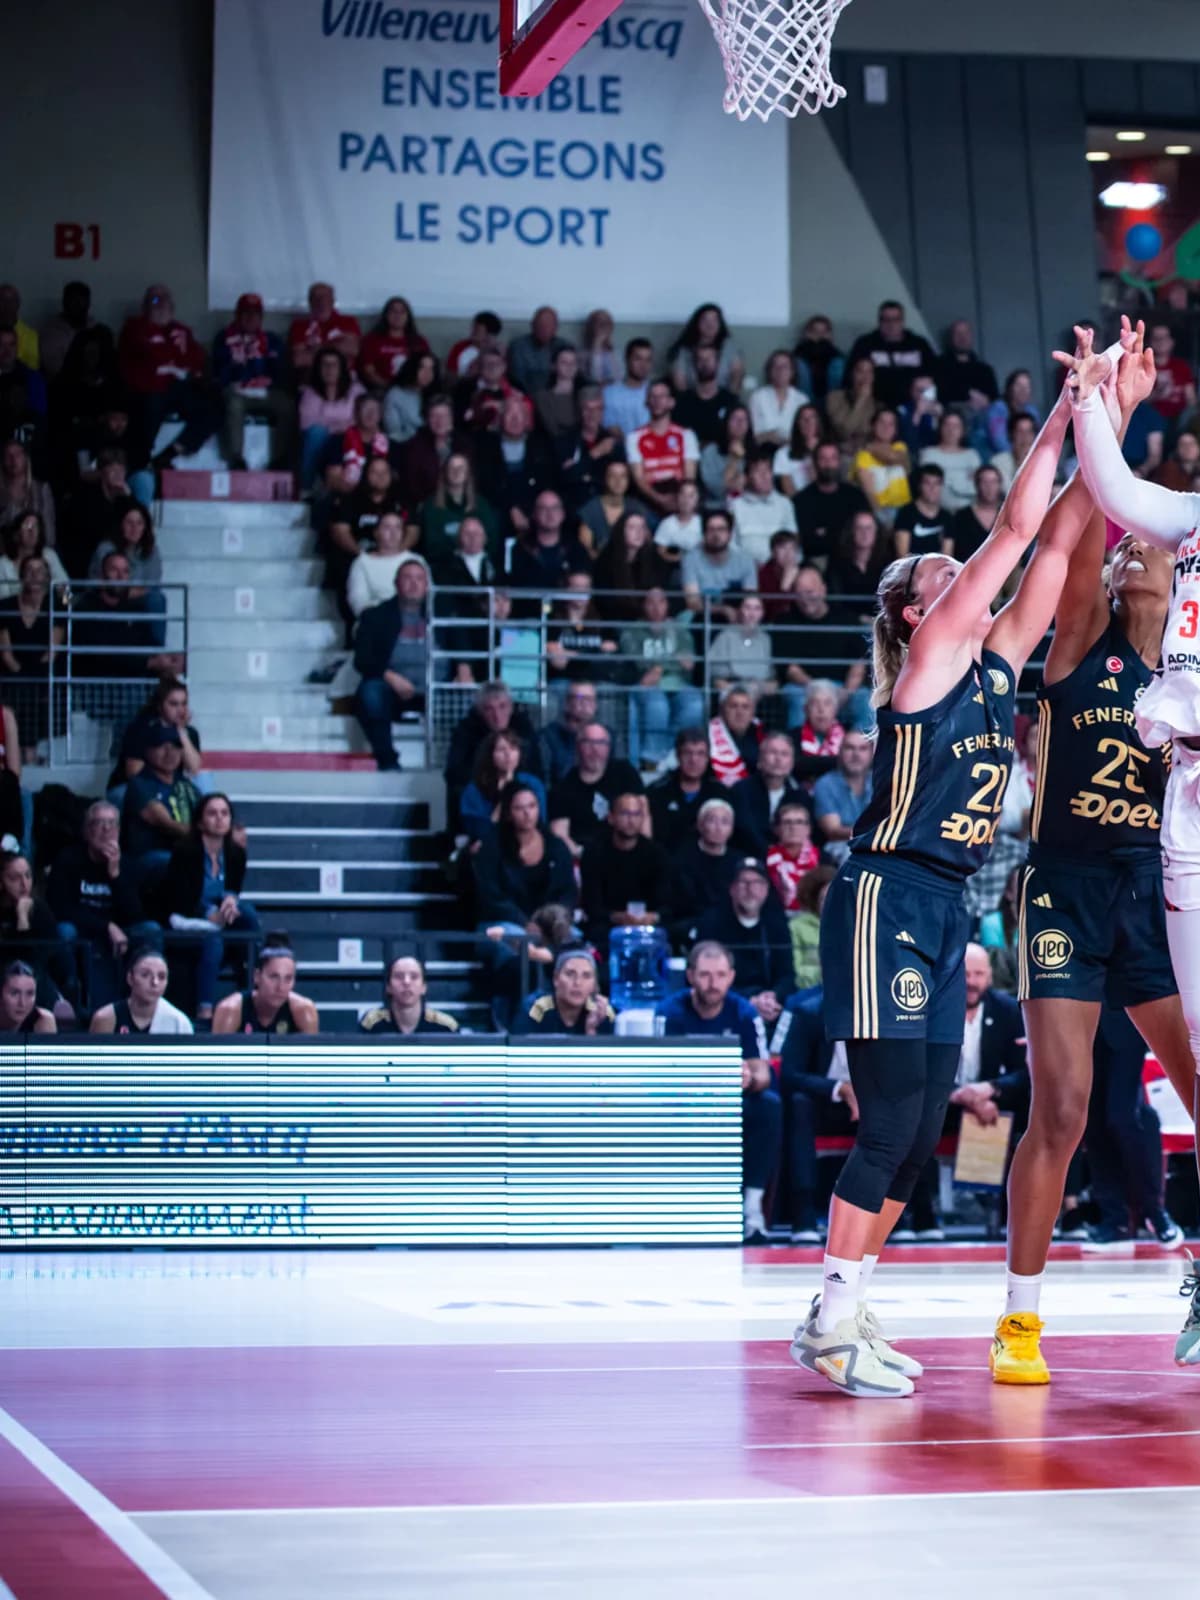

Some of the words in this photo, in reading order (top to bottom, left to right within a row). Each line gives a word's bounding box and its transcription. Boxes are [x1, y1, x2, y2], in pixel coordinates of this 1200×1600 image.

[320, 0, 499, 44] Villeneuv
[338, 131, 666, 182] PARTAGEONS
[54, 223, 100, 260] B1
[395, 202, 440, 241] LE
[457, 204, 610, 247] SPORT
[1072, 706, 1137, 730] FENER
[1091, 737, 1150, 793] 25
